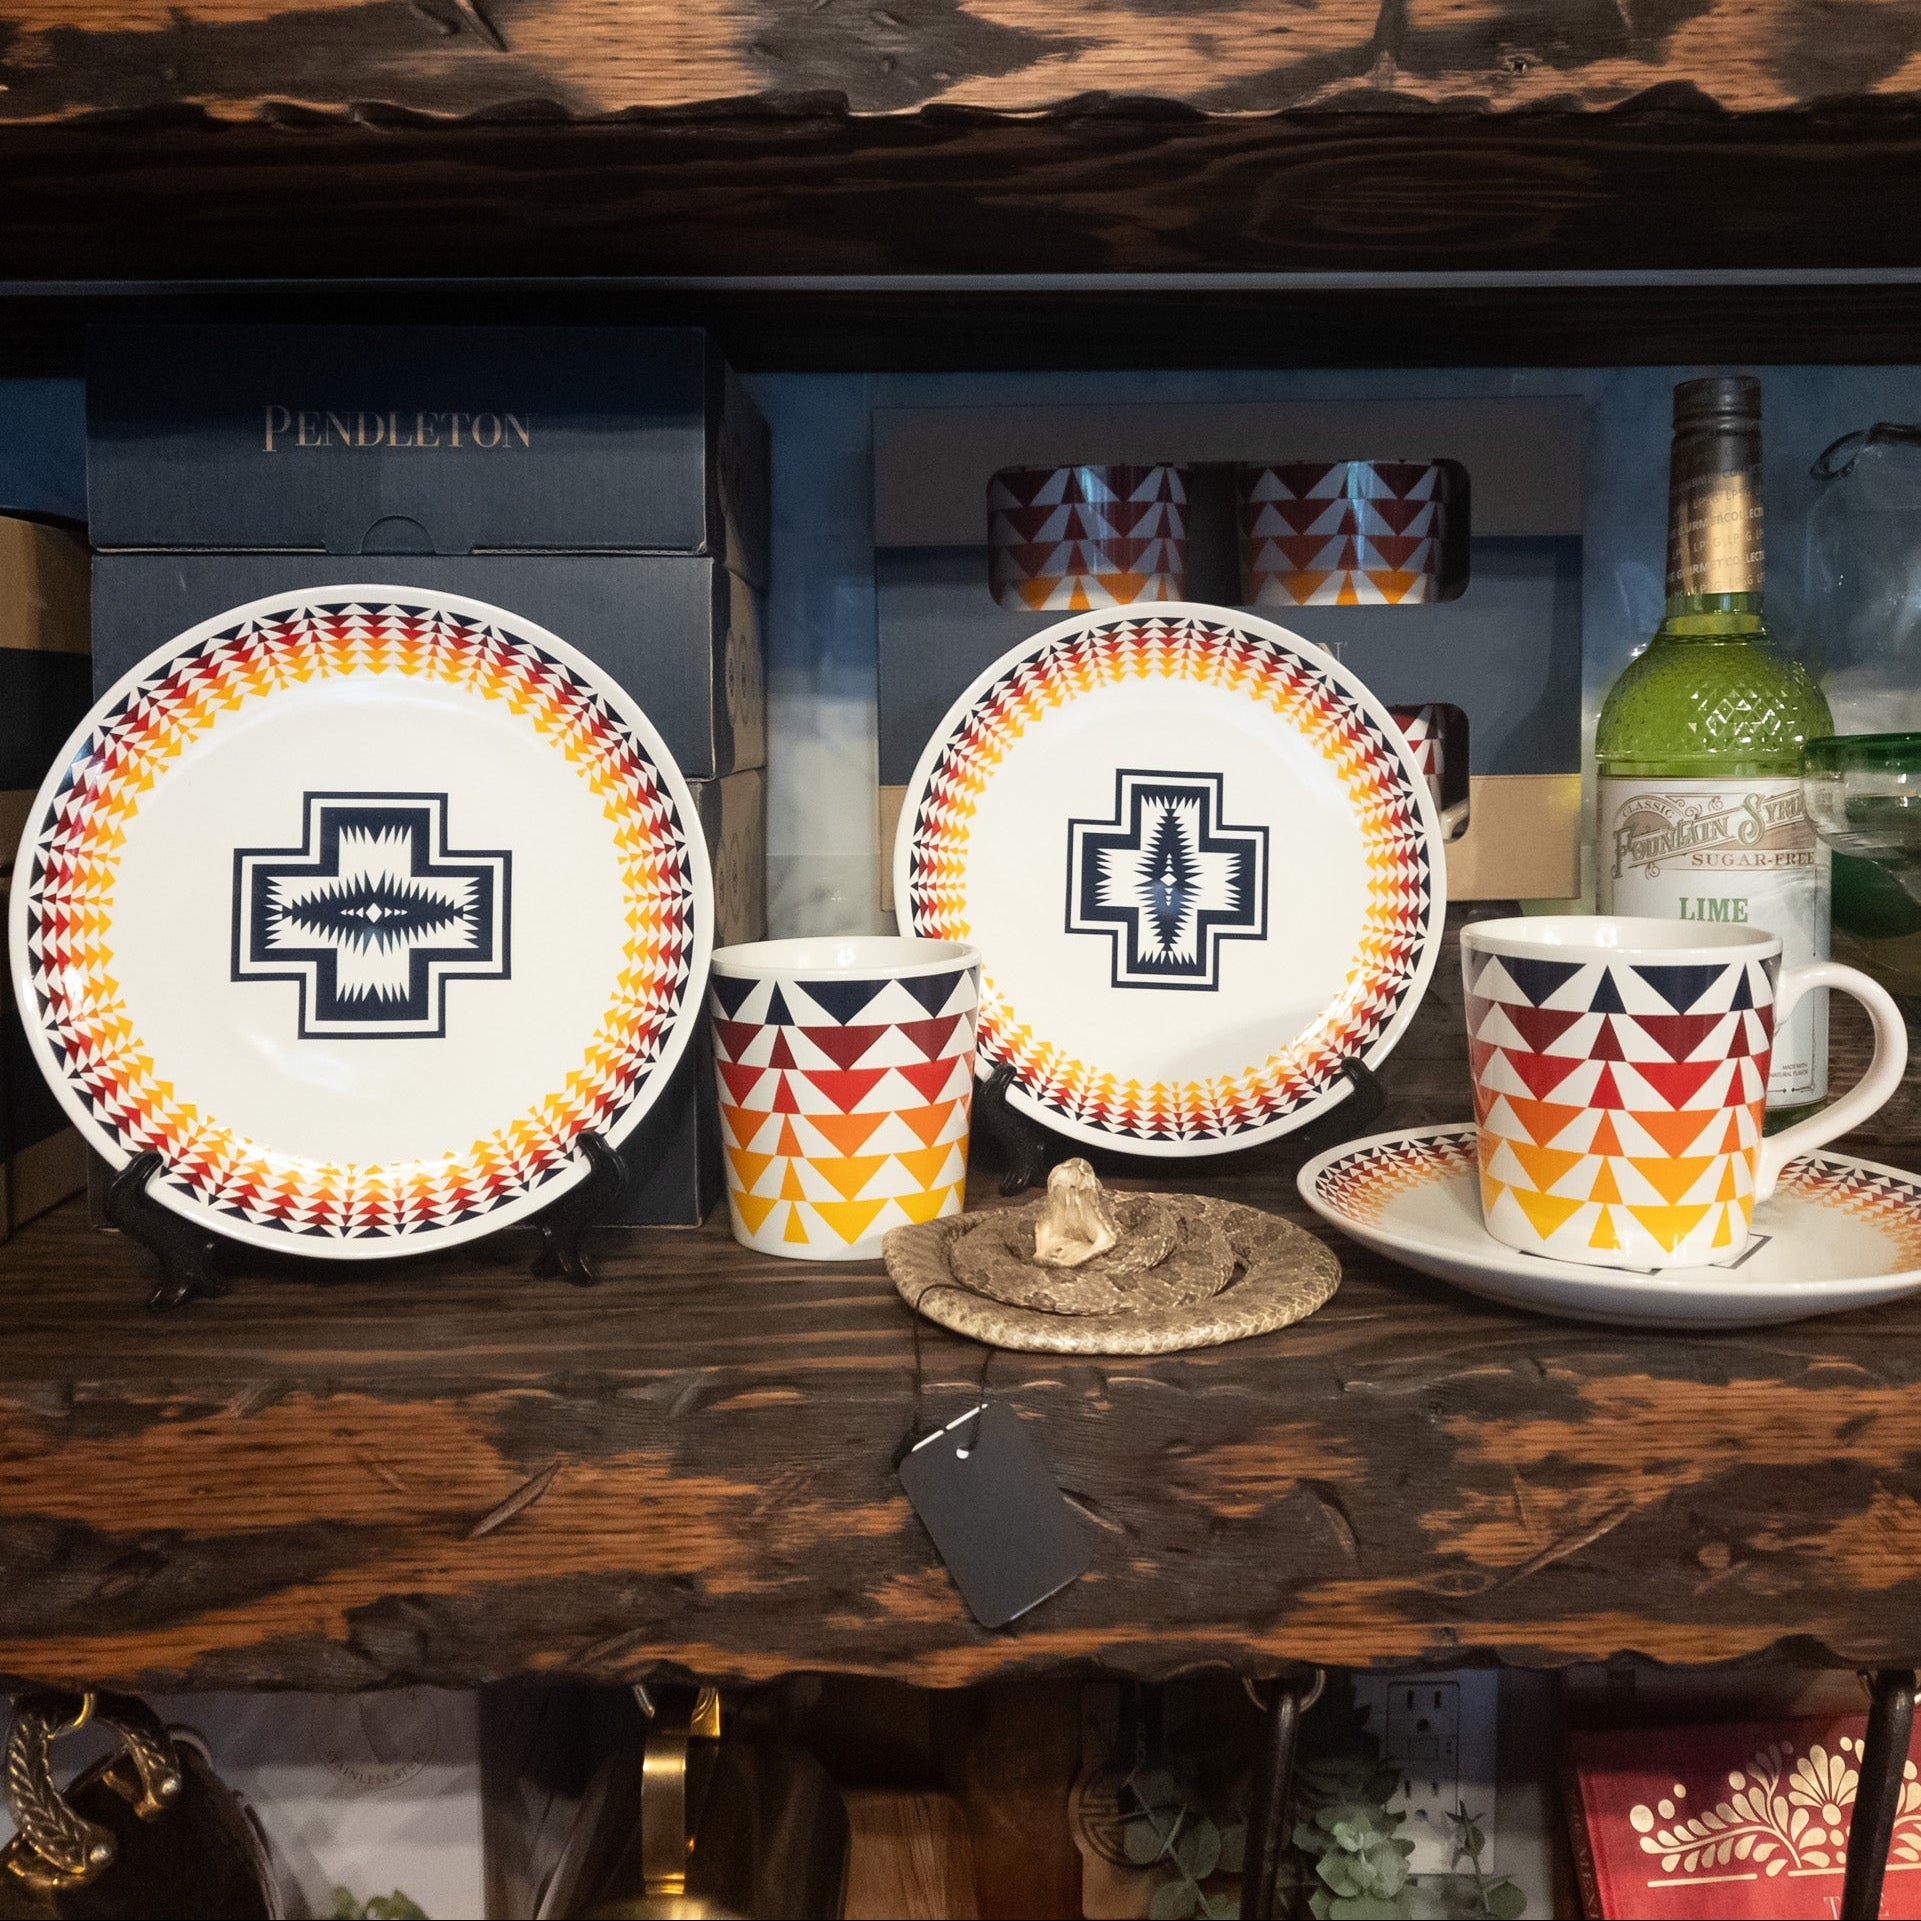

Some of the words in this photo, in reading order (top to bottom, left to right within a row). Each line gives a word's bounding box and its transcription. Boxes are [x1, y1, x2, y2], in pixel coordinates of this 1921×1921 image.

[261, 404, 530, 452] PENDLETON
[1622, 801, 1675, 819] CLASSIC
[1691, 852, 1814, 867] SUGAR-FREE
[1679, 897, 1748, 923] LIME
